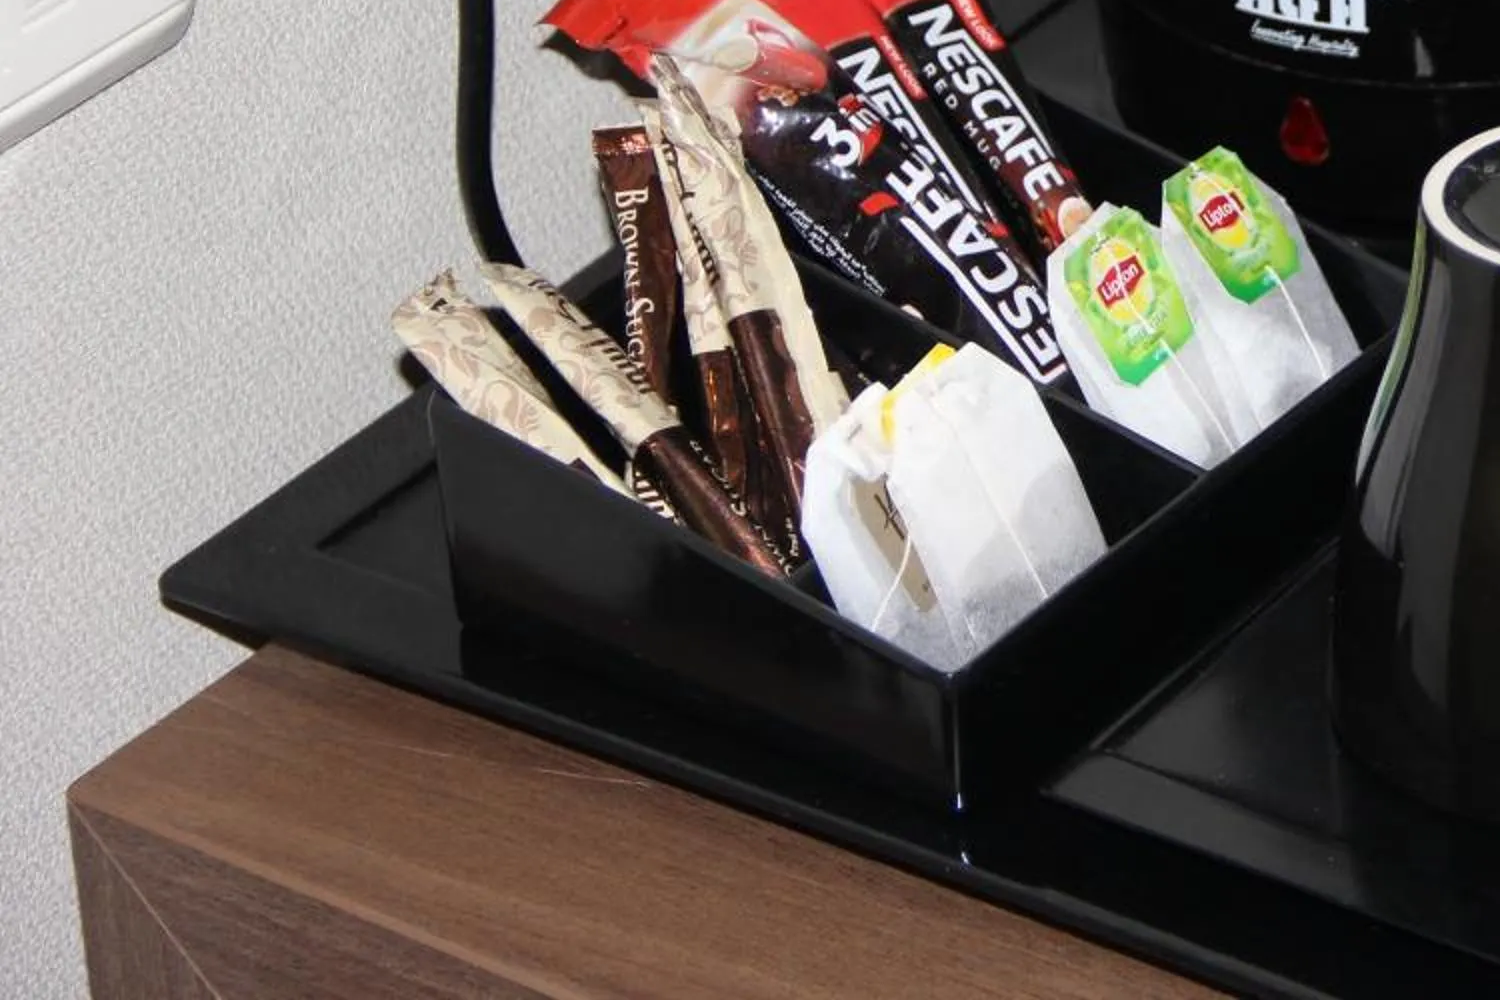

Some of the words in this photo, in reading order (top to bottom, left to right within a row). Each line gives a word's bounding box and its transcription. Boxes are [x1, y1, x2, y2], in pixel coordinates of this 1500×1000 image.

[922, 63, 960, 111] RED
[963, 119, 1002, 171] MUG
[1203, 200, 1238, 227] Lipto
[886, 153, 1066, 384] ESCAFE
